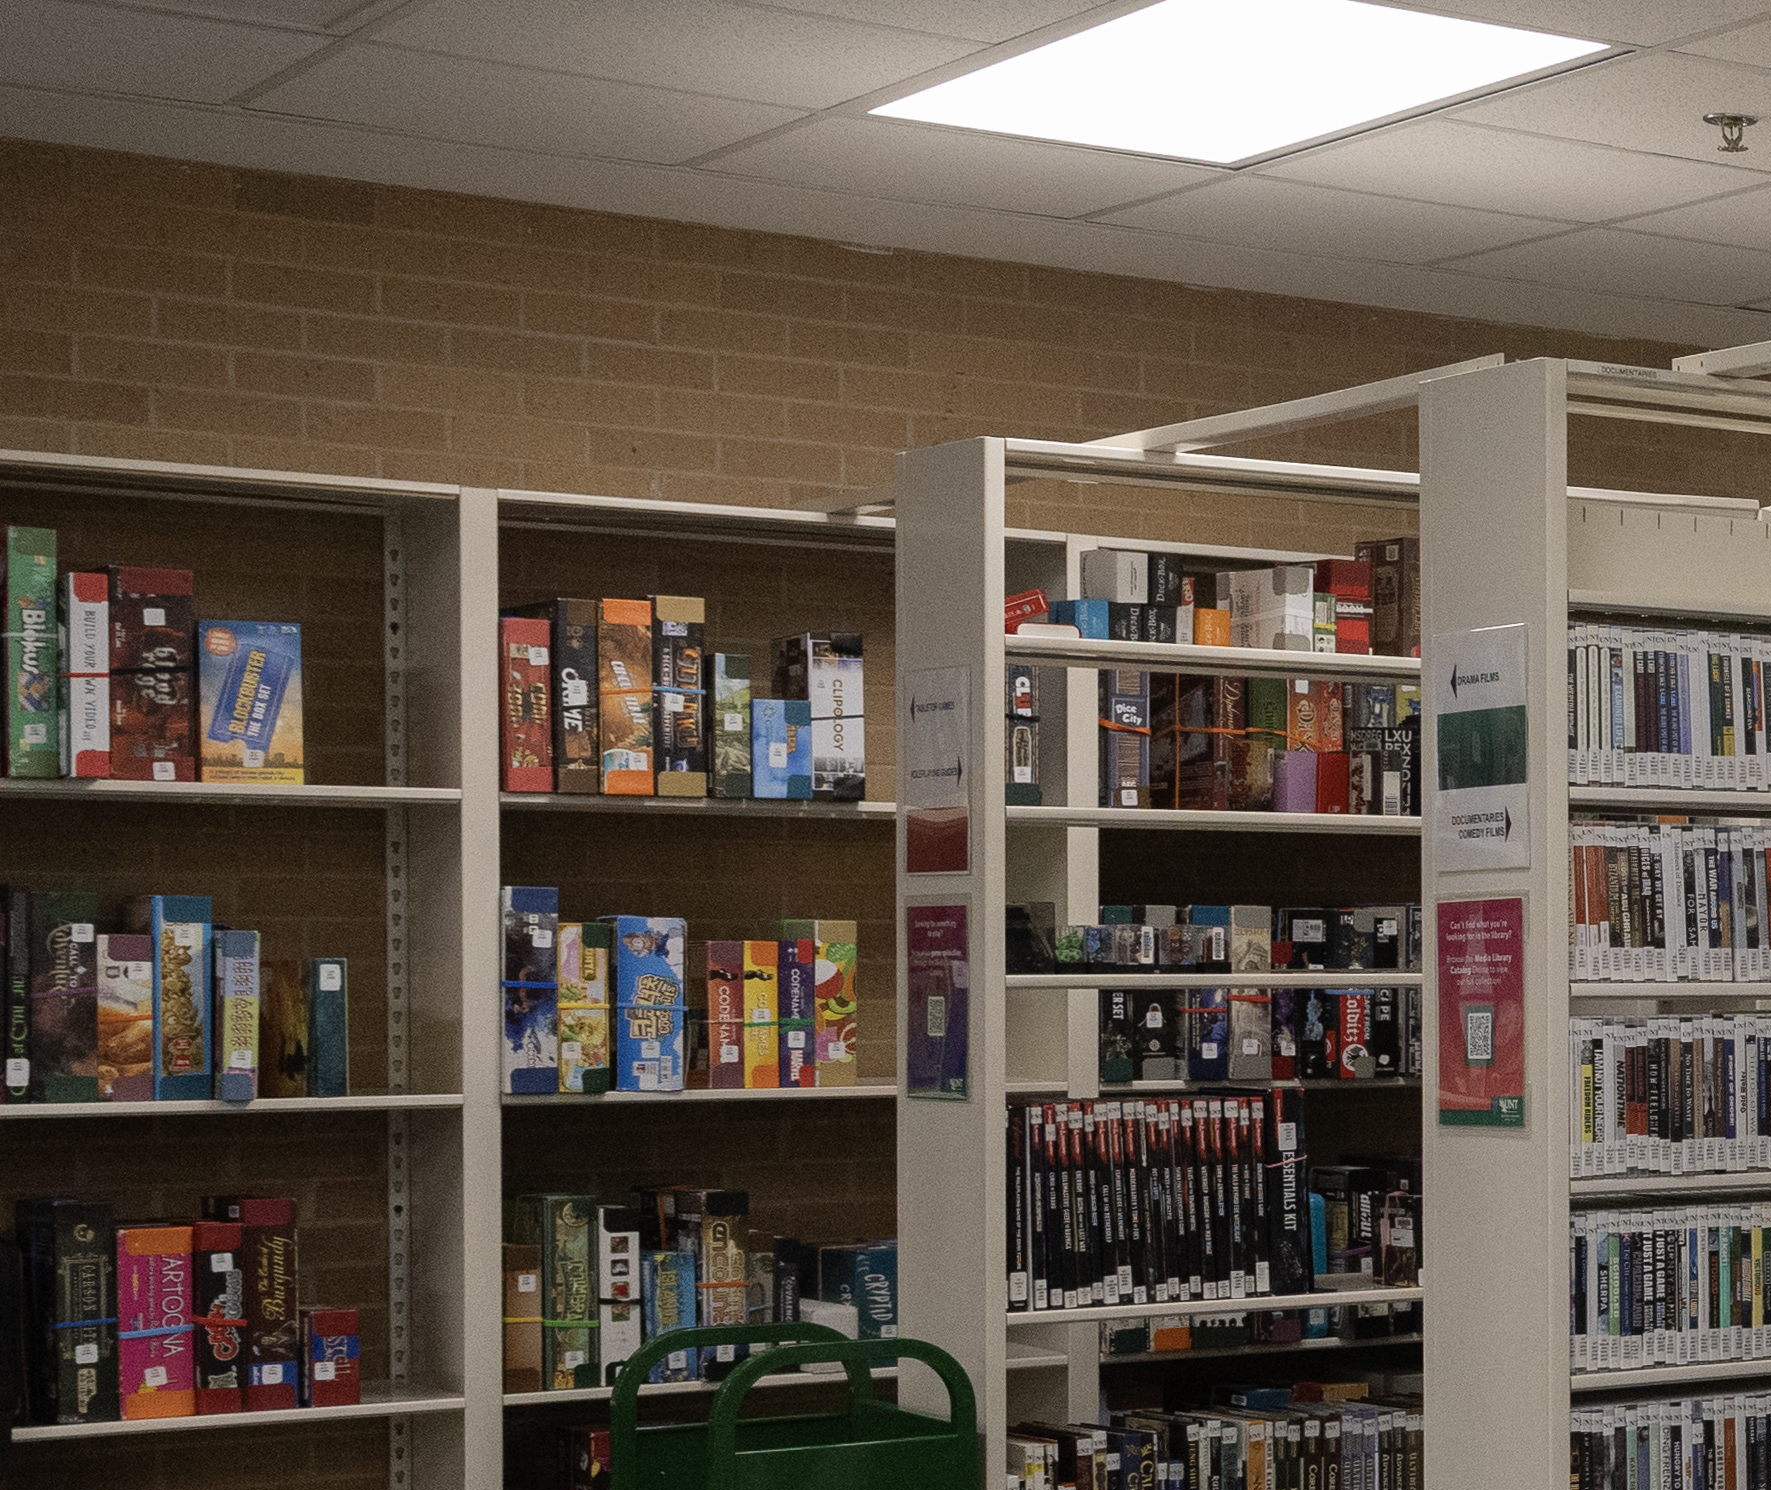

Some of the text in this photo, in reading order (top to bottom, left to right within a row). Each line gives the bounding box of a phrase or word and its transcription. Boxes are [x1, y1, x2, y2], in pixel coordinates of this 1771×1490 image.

[21, 608, 47, 675] Blokus
[229, 650, 267, 735] BLOCKBUSTER
[1457, 671, 1500, 686] DRAMA FILMS
[247, 683, 272, 736] THE BOX SET
[1115, 702, 1138, 718] Dice
[1121, 712, 1143, 727] City
[1452, 811, 1505, 826] DOCUMENTARIES
[1458, 826, 1505, 840] COMEDY FILMS
[1446, 933, 1466, 943] looking
[1491, 929, 1512, 940] library?
[1450, 919, 1508, 930] Can't find what you're
[69, 941, 78, 989] CALL TO
[1491, 953, 1513, 963] Library
[1583, 1076, 1592, 1134] FREEDOM RIDERS
[1616, 1060, 1626, 1129] NATIONTIME
[1281, 1150, 1298, 1233] ESSENTIALS KIT
[864, 1272, 893, 1322] CRYPTID
[1600, 1270, 1608, 1311] SHERPA
